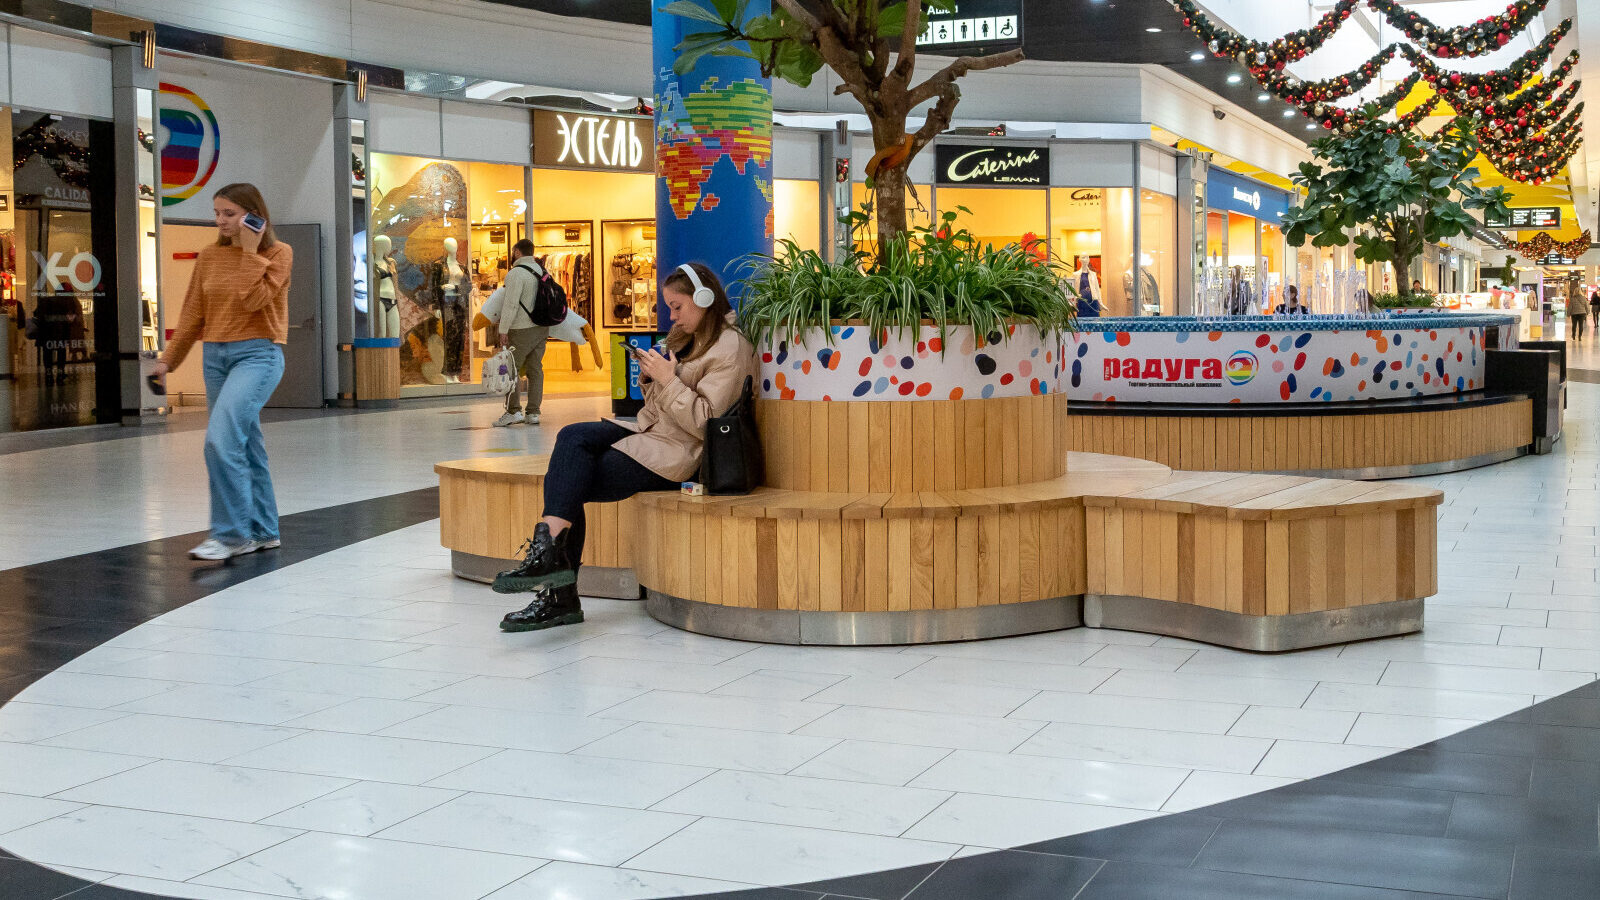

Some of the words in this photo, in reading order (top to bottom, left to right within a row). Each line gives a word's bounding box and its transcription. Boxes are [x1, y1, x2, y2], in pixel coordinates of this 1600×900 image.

[556, 114, 643, 168] ЭСТЕЛЬ
[947, 148, 1040, 182] Caterina
[44, 186, 89, 201] CALIDA
[1103, 357, 1223, 382] радуга
